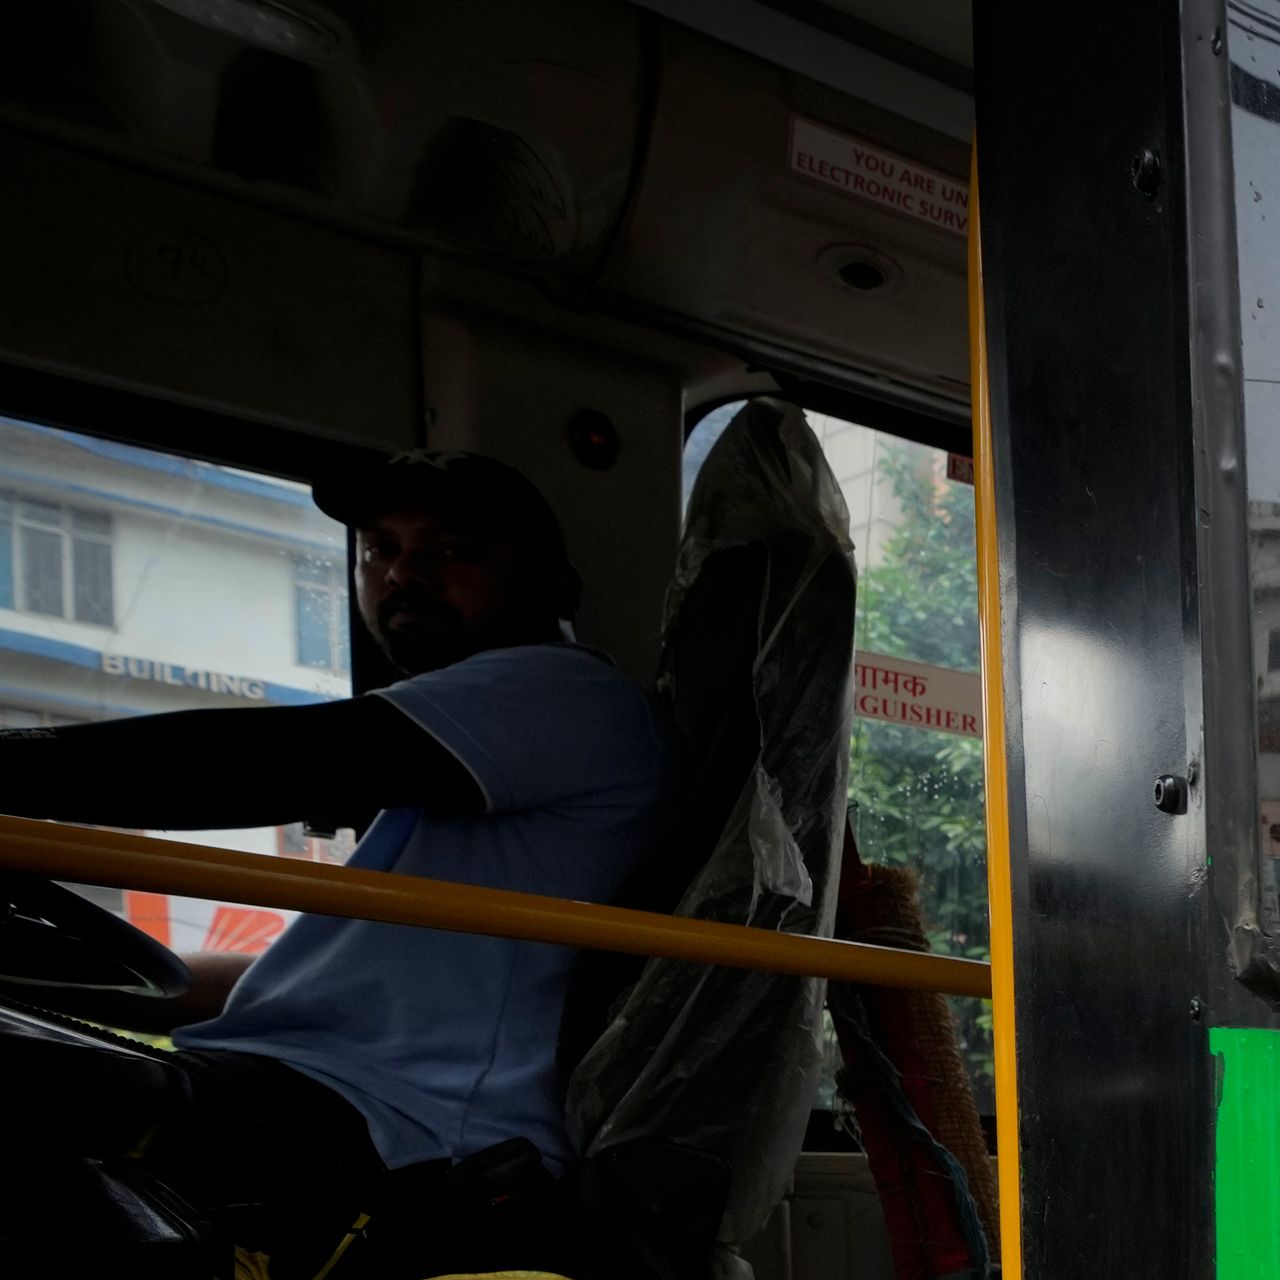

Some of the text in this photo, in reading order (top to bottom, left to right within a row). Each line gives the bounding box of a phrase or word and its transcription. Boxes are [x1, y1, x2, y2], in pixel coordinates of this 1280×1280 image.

[797, 151, 913, 211] ELECTRONIC
[852, 147, 894, 179] YOU
[900, 170, 935, 196] ARE
[855, 694, 977, 733] GUISHER
